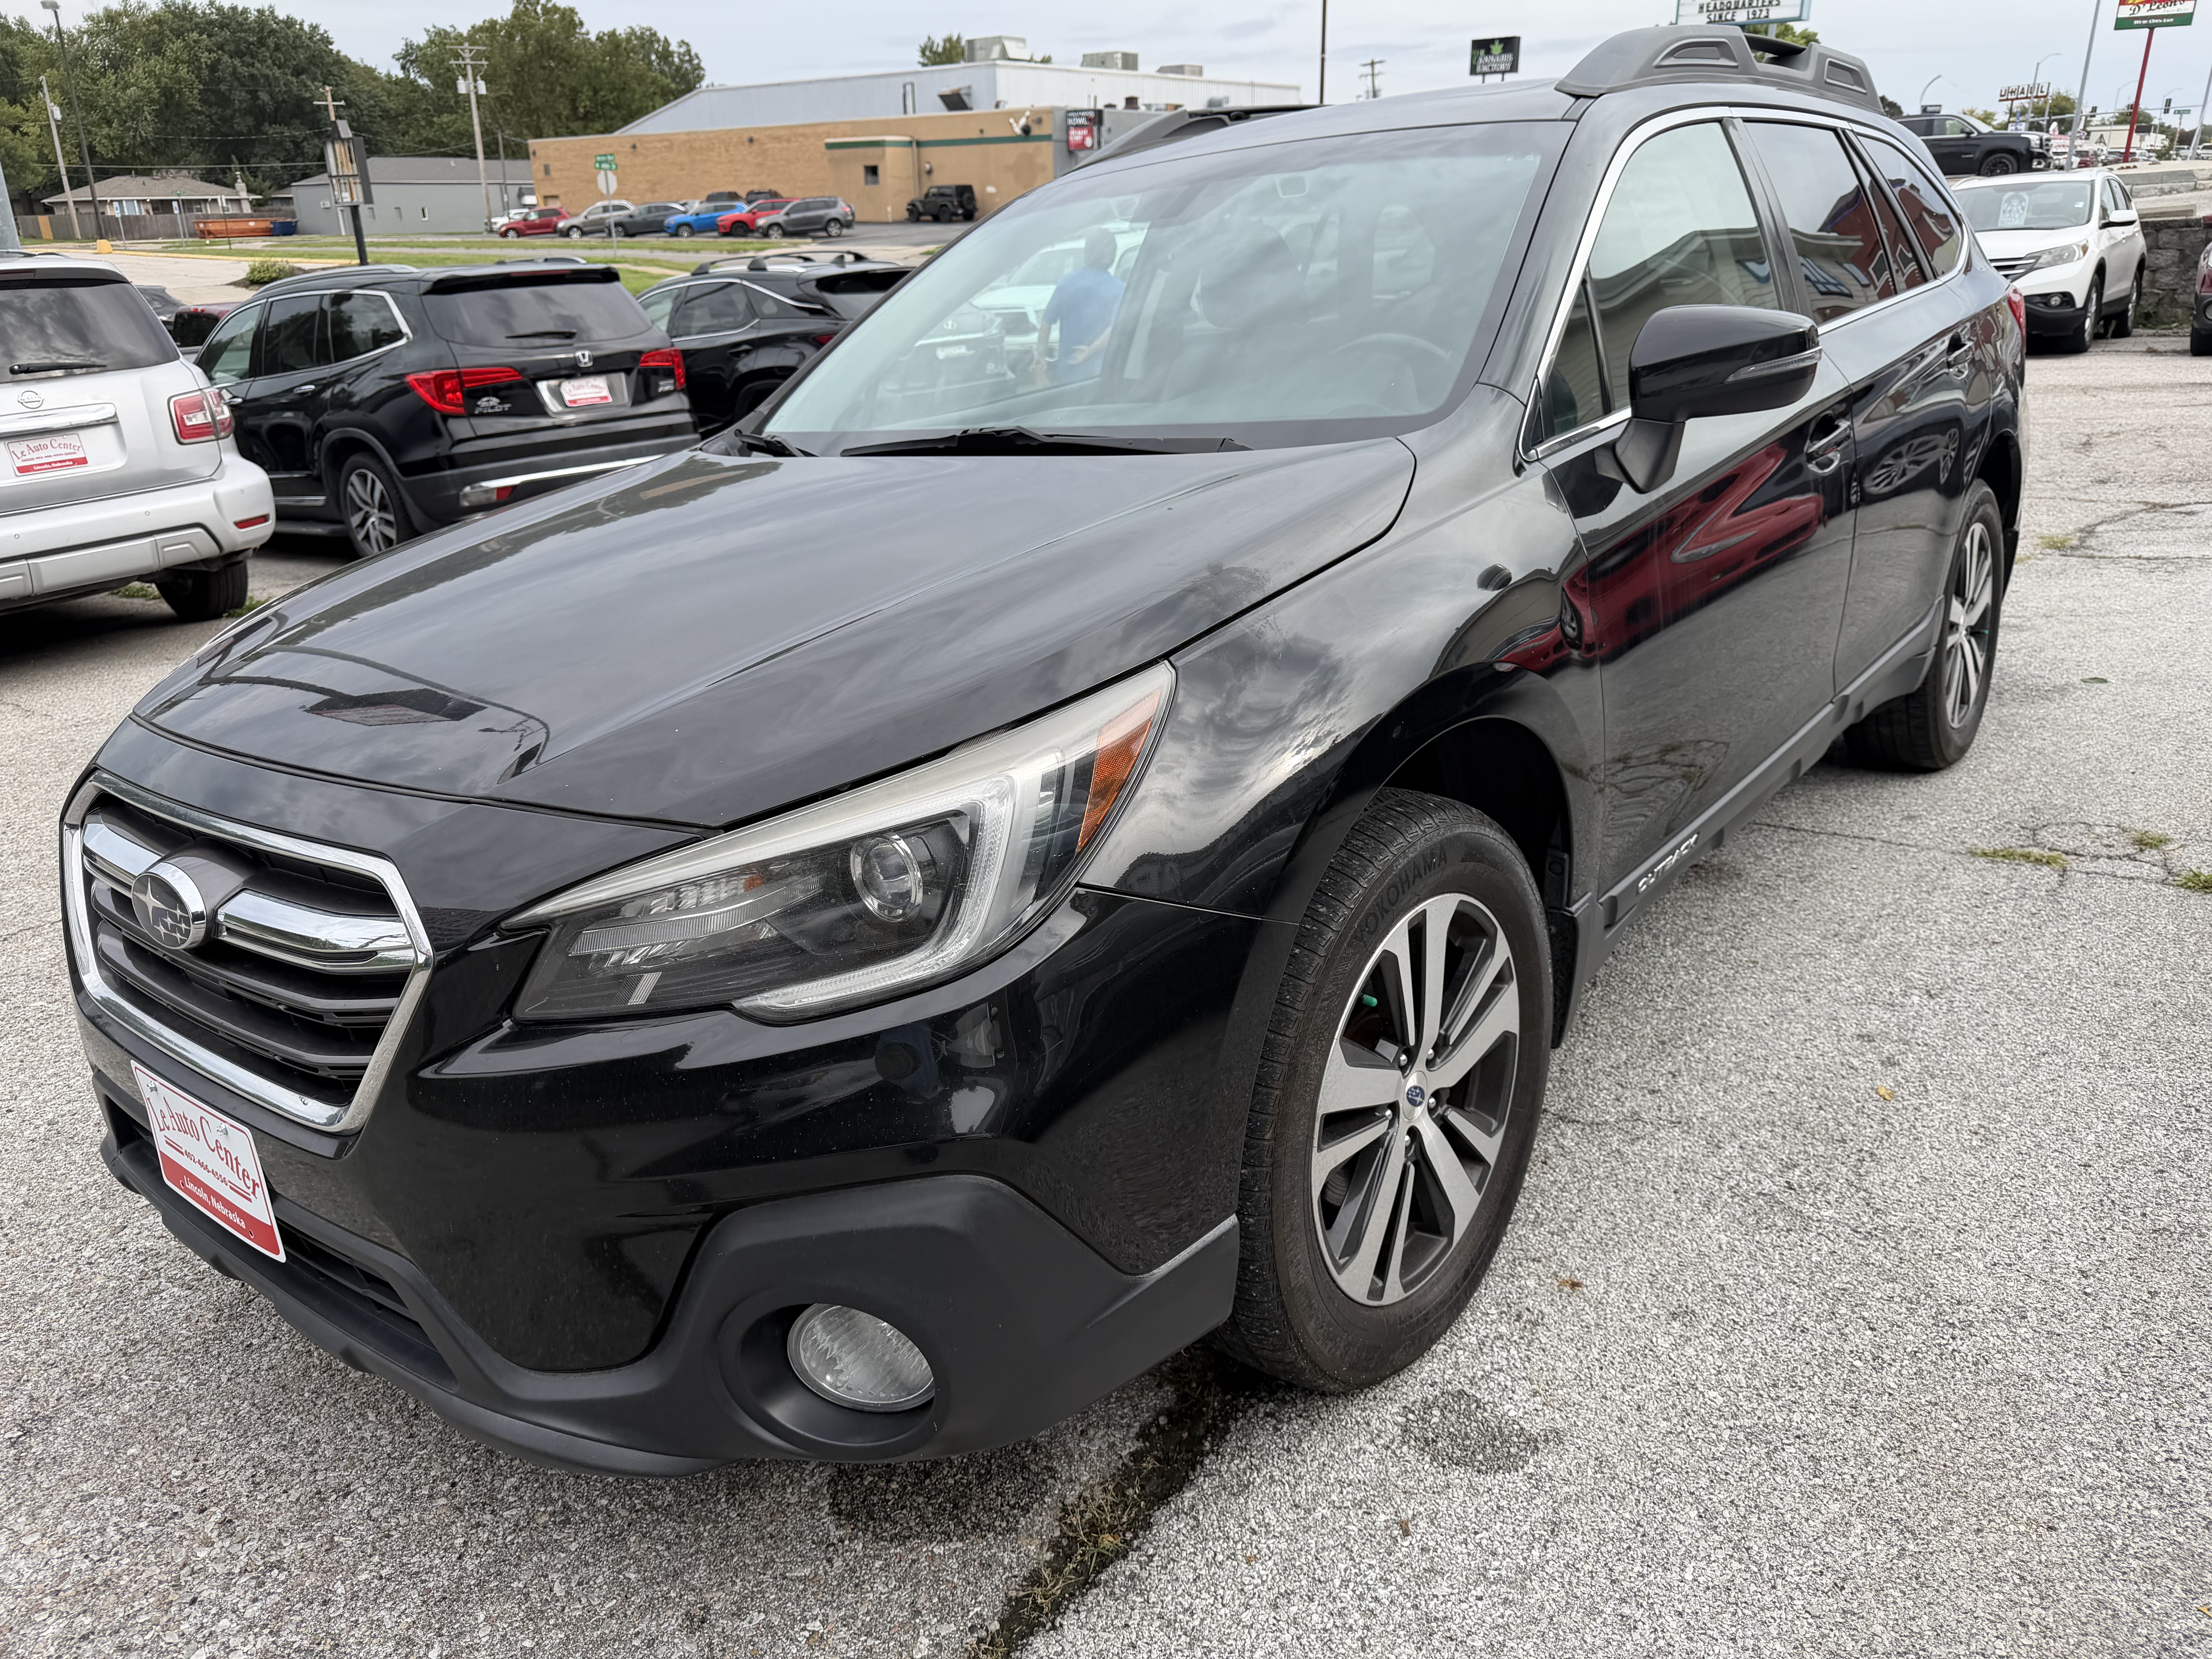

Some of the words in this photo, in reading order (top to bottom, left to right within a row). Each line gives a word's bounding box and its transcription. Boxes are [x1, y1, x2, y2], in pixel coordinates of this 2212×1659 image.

[1706, 11, 1737, 24] SINCE
[1747, 9, 1769, 20] 1973
[474, 404, 512, 414] PILOT
[12, 450, 27, 460] Le
[26, 443, 48, 455] Auto
[50, 438, 82, 452] Center
[1353, 844, 1448, 948] YOKOHAMA
[147, 1097, 170, 1132] Le
[163, 1096, 200, 1142] Auto
[199, 1116, 260, 1199] Center
[184, 1149, 228, 1187] 402-466-4556
[183, 1175, 211, 1206] Lincoln,
[211, 1196, 246, 1229] Nebraska
